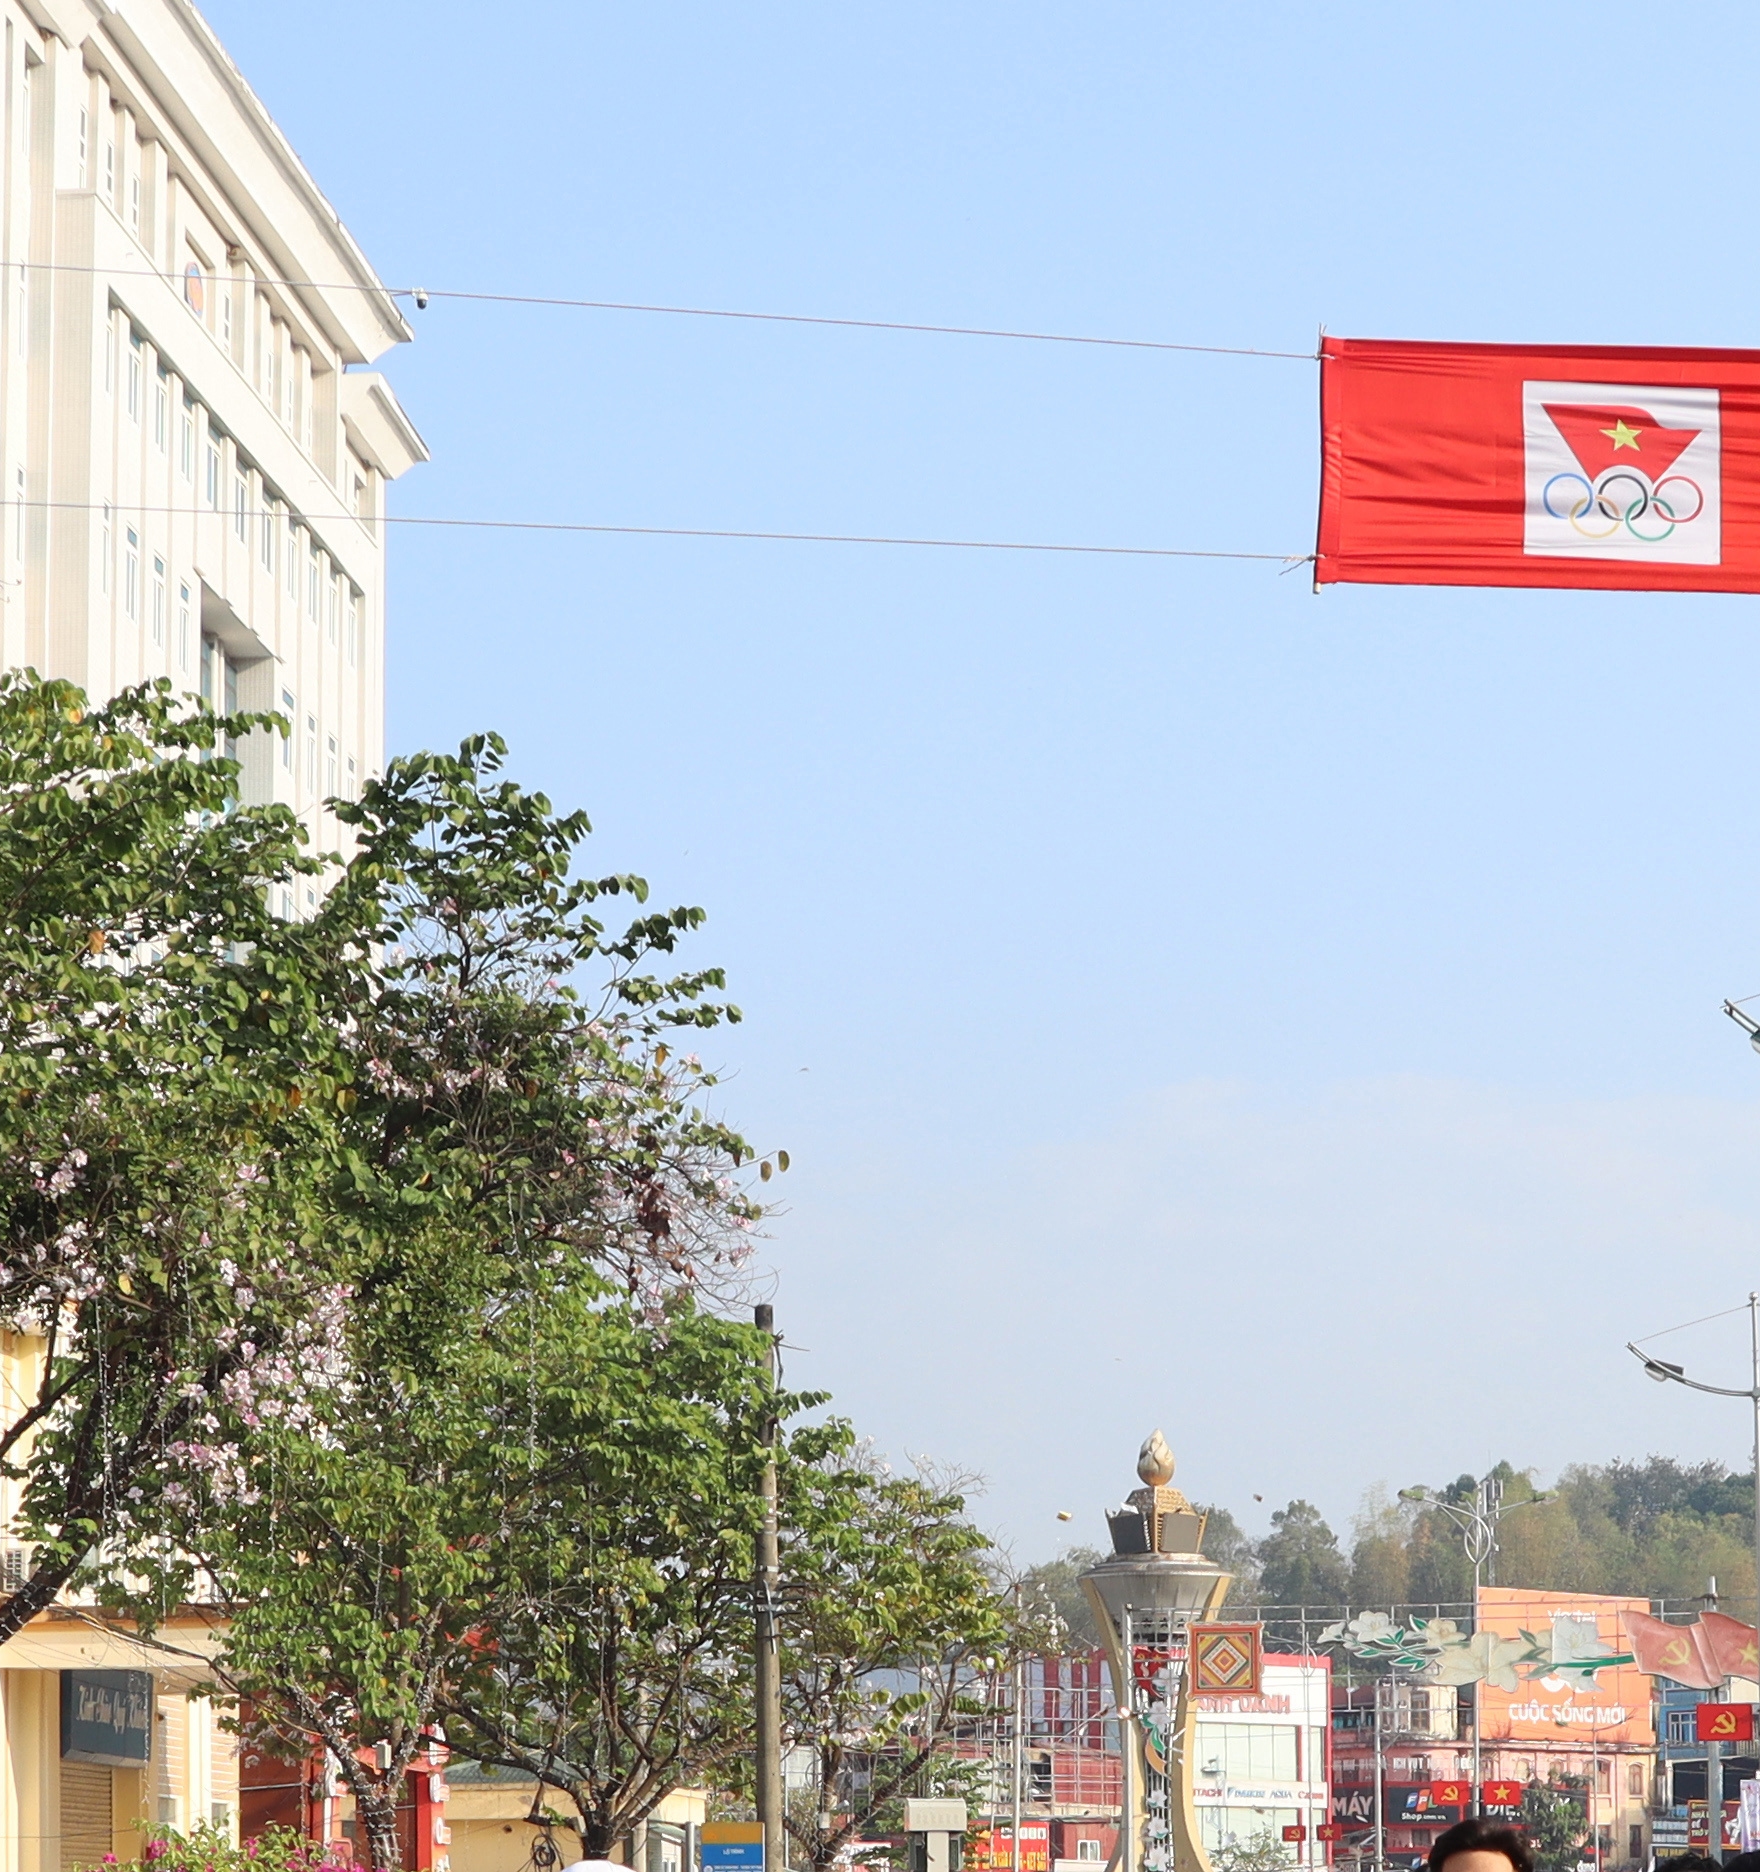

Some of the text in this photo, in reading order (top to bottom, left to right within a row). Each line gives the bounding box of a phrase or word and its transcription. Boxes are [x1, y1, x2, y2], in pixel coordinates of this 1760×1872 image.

[1508, 1696, 1627, 1725] CUỘC SỐNG MỚI
[1333, 1791, 1374, 1817] MÁY
